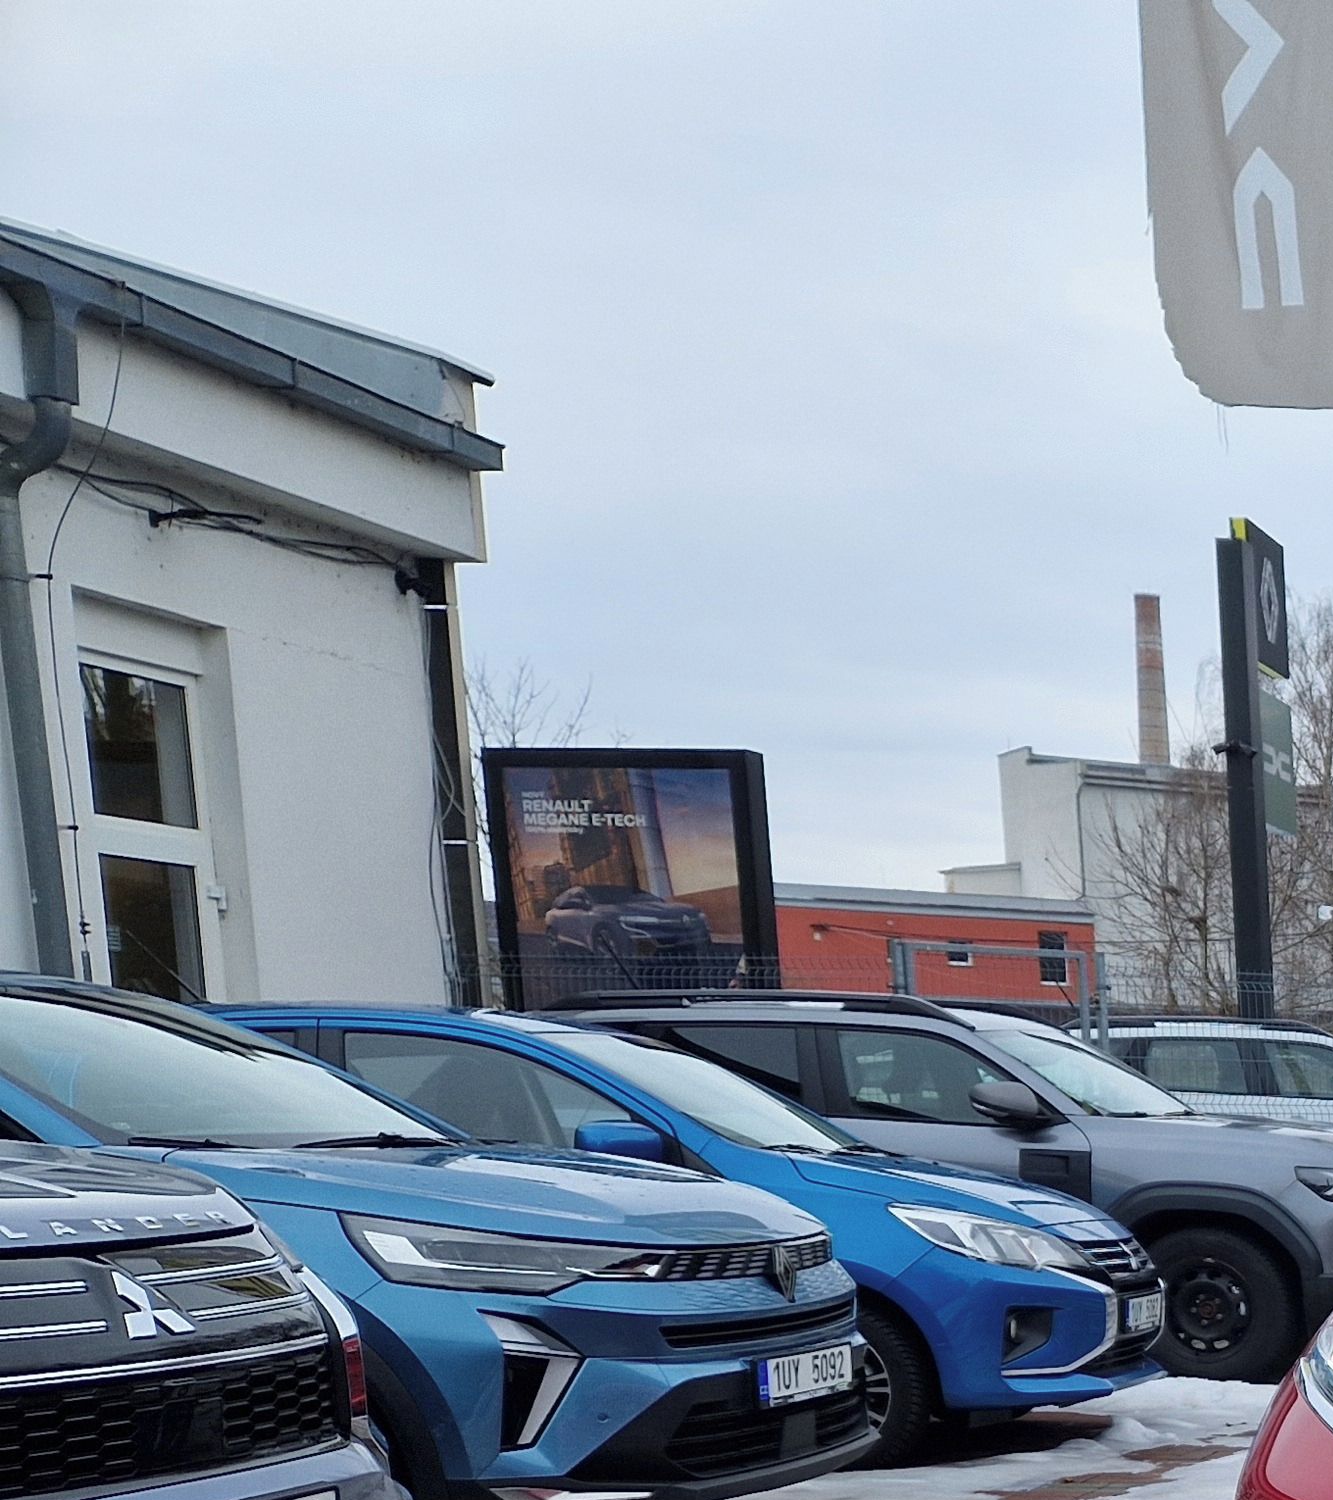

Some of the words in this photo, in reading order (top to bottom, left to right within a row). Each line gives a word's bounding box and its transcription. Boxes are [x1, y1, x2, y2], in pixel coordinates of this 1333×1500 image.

[522, 800, 594, 813] RENAULT
[523, 813, 590, 826] MEGANE
[591, 813, 648, 828] E-TECH
[0, 1210, 233, 1240] LANDER
[773, 1358, 800, 1392] 1UY
[812, 1350, 844, 1384] 5092
